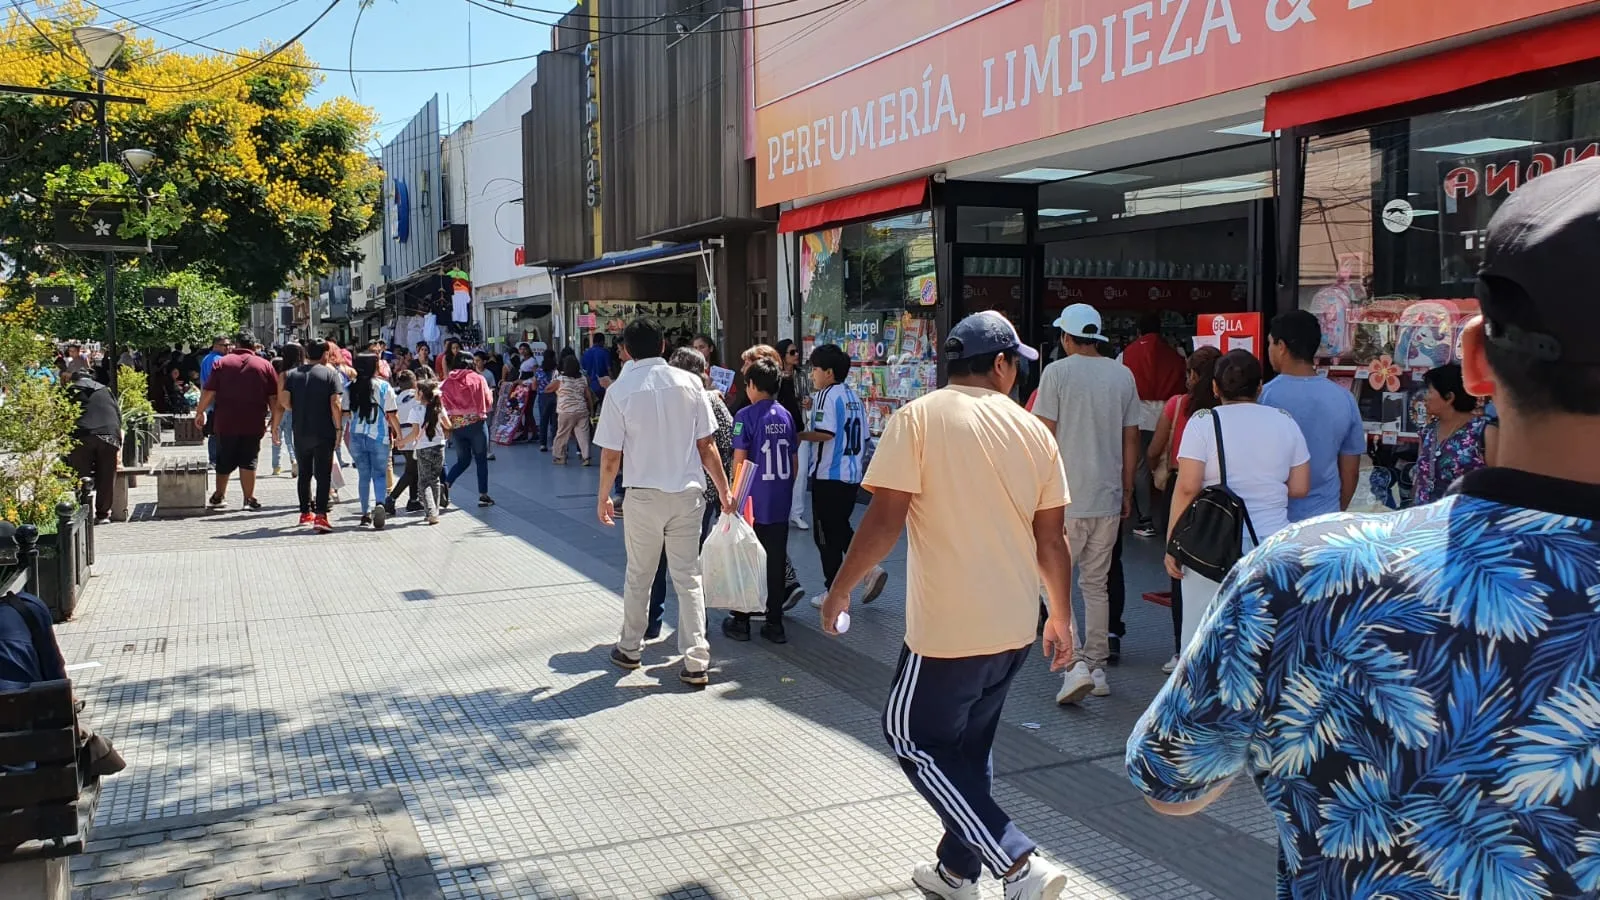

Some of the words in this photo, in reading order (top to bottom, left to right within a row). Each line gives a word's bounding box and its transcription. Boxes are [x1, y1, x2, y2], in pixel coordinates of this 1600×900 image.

[768, 64, 966, 180] PERFUMERÍA,
[982, 0, 1241, 117] LIMPIEZA
[585, 43, 600, 207] cintas
[844, 318, 868, 339] Llegó
[870, 318, 879, 334] el
[1212, 317, 1243, 333] BELLA
[765, 423, 787, 434] MESSI
[844, 417, 861, 456] 10
[761, 438, 791, 480] 10
